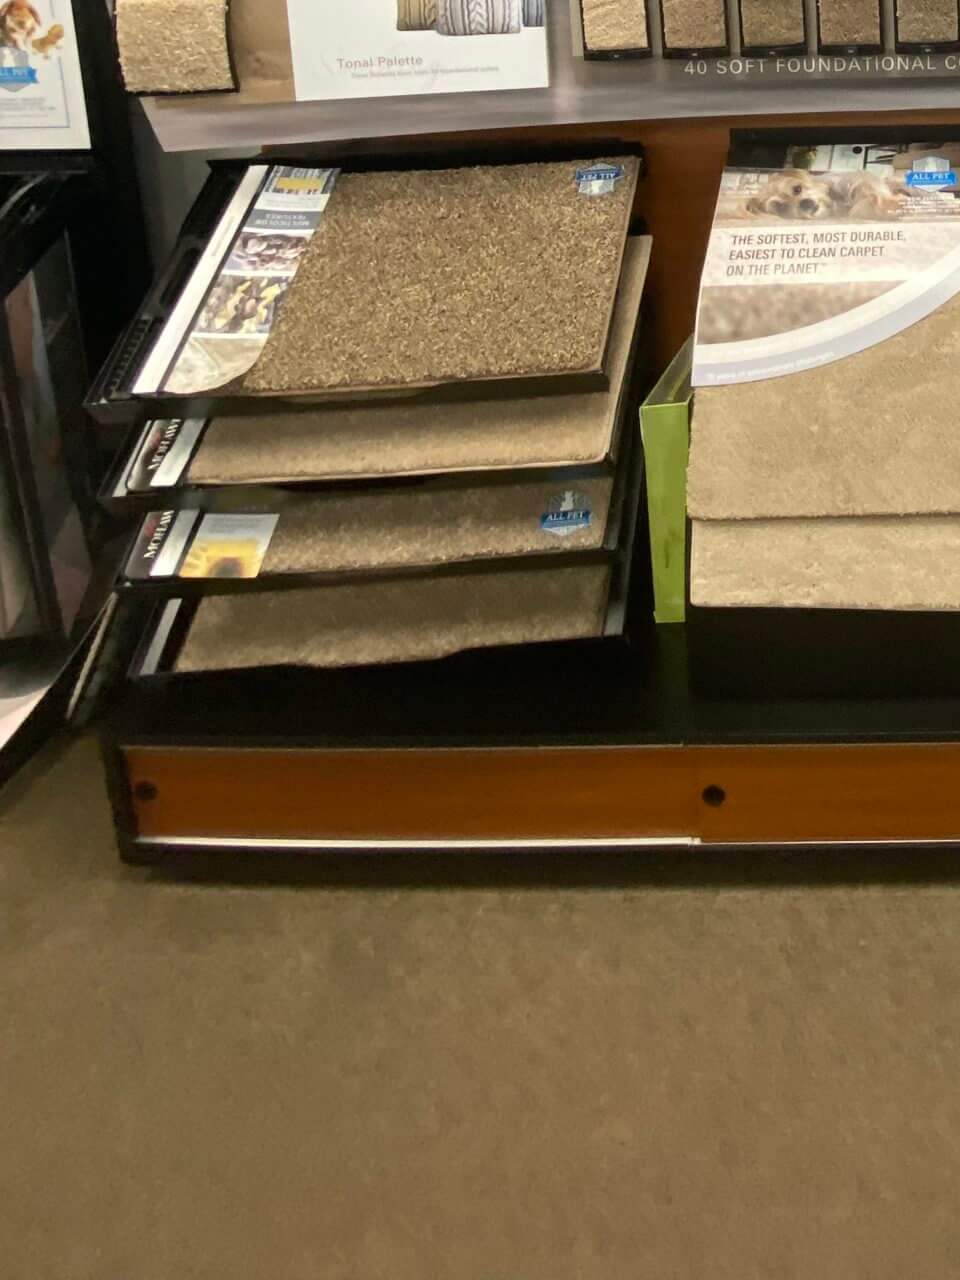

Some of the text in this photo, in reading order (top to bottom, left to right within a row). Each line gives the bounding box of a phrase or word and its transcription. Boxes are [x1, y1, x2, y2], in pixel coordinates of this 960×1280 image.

[336, 56, 424, 70] Tonal Palette
[684, 60, 707, 75] 40
[716, 59, 766, 74] SOFT
[775, 56, 937, 74] FOUNDATIONAL
[911, 172, 931, 180] ALL
[731, 230, 907, 246] THE SOFTEST, MOST DURABLE,
[728, 246, 886, 261] EASIEST TO CLEAN CARPET
[726, 264, 745, 277] ON
[747, 263, 770, 276] THE
[546, 513, 566, 521] ALL
